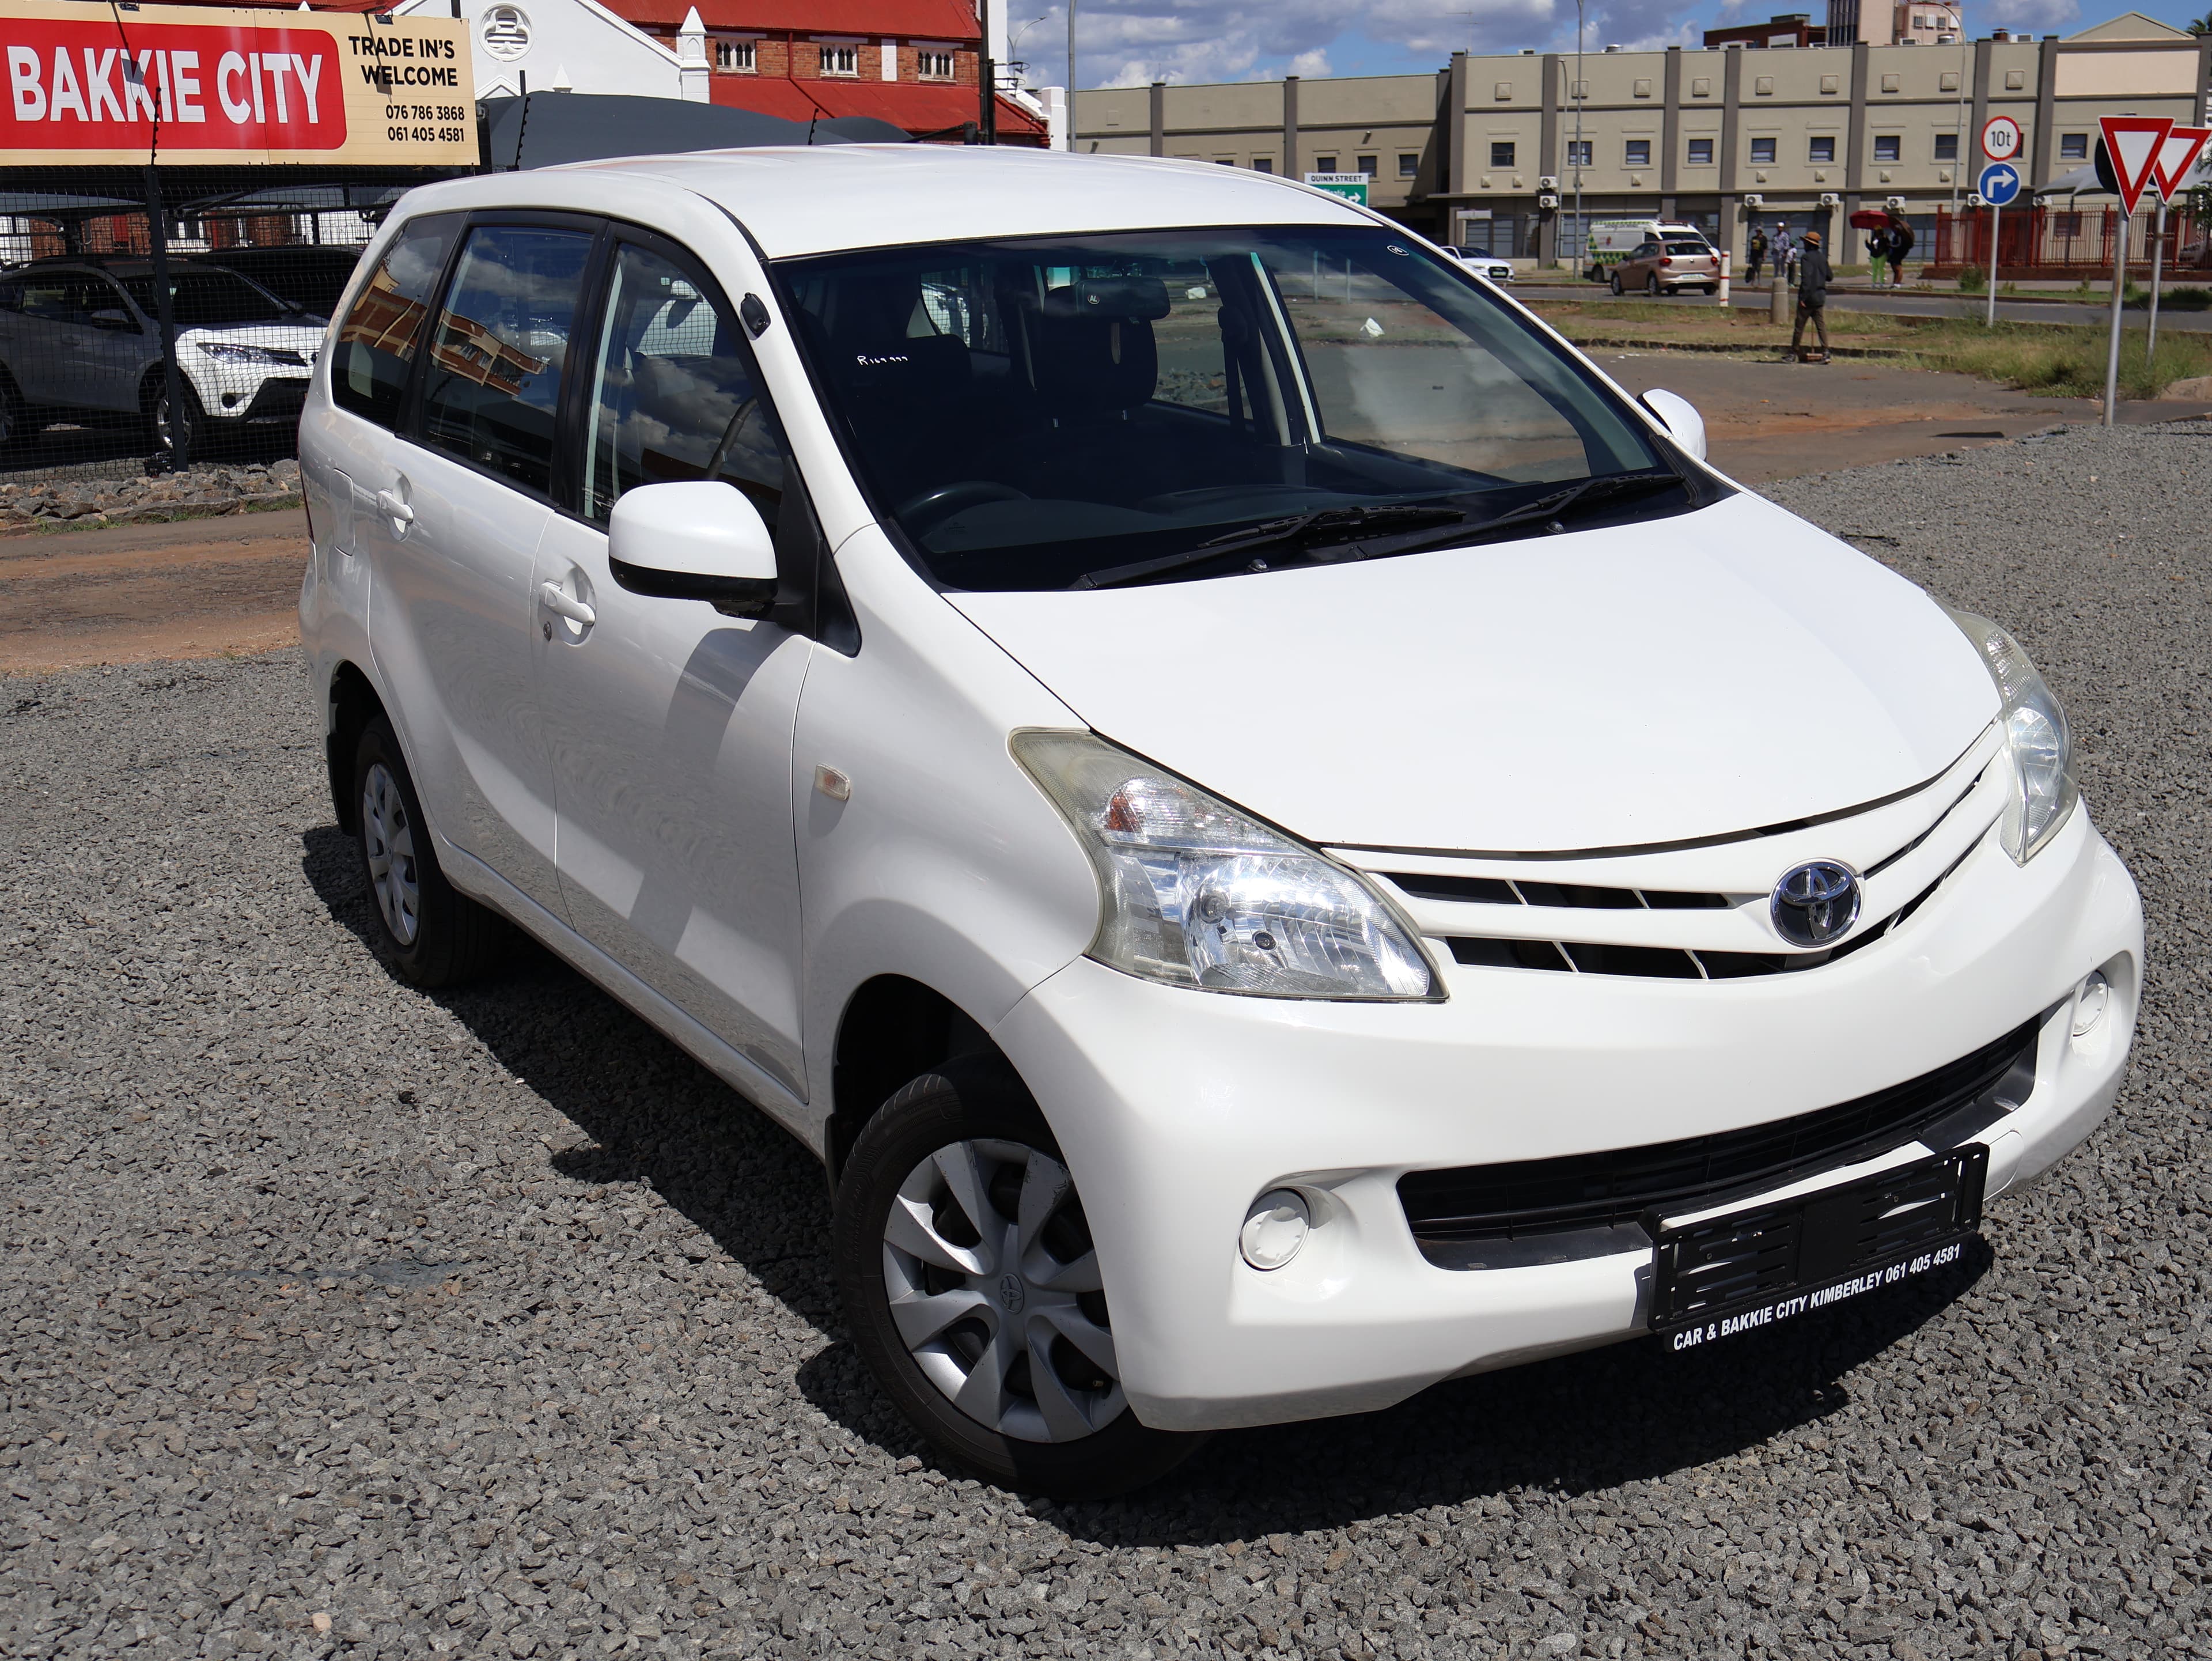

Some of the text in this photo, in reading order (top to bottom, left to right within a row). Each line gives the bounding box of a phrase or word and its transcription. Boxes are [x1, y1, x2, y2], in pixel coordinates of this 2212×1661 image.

[348, 35, 455, 59] TRADE IN'S
[7, 46, 323, 124] BAKKIE CITY
[361, 65, 459, 86] WELCOME
[385, 104, 465, 120] 076 786 3868
[388, 126, 464, 142] 061 405 4581
[1991, 130, 2011, 147] 10t
[1673, 1243, 1961, 1350] CAR & BAKKIE CITY KIMBERLEY 061 405 4581
